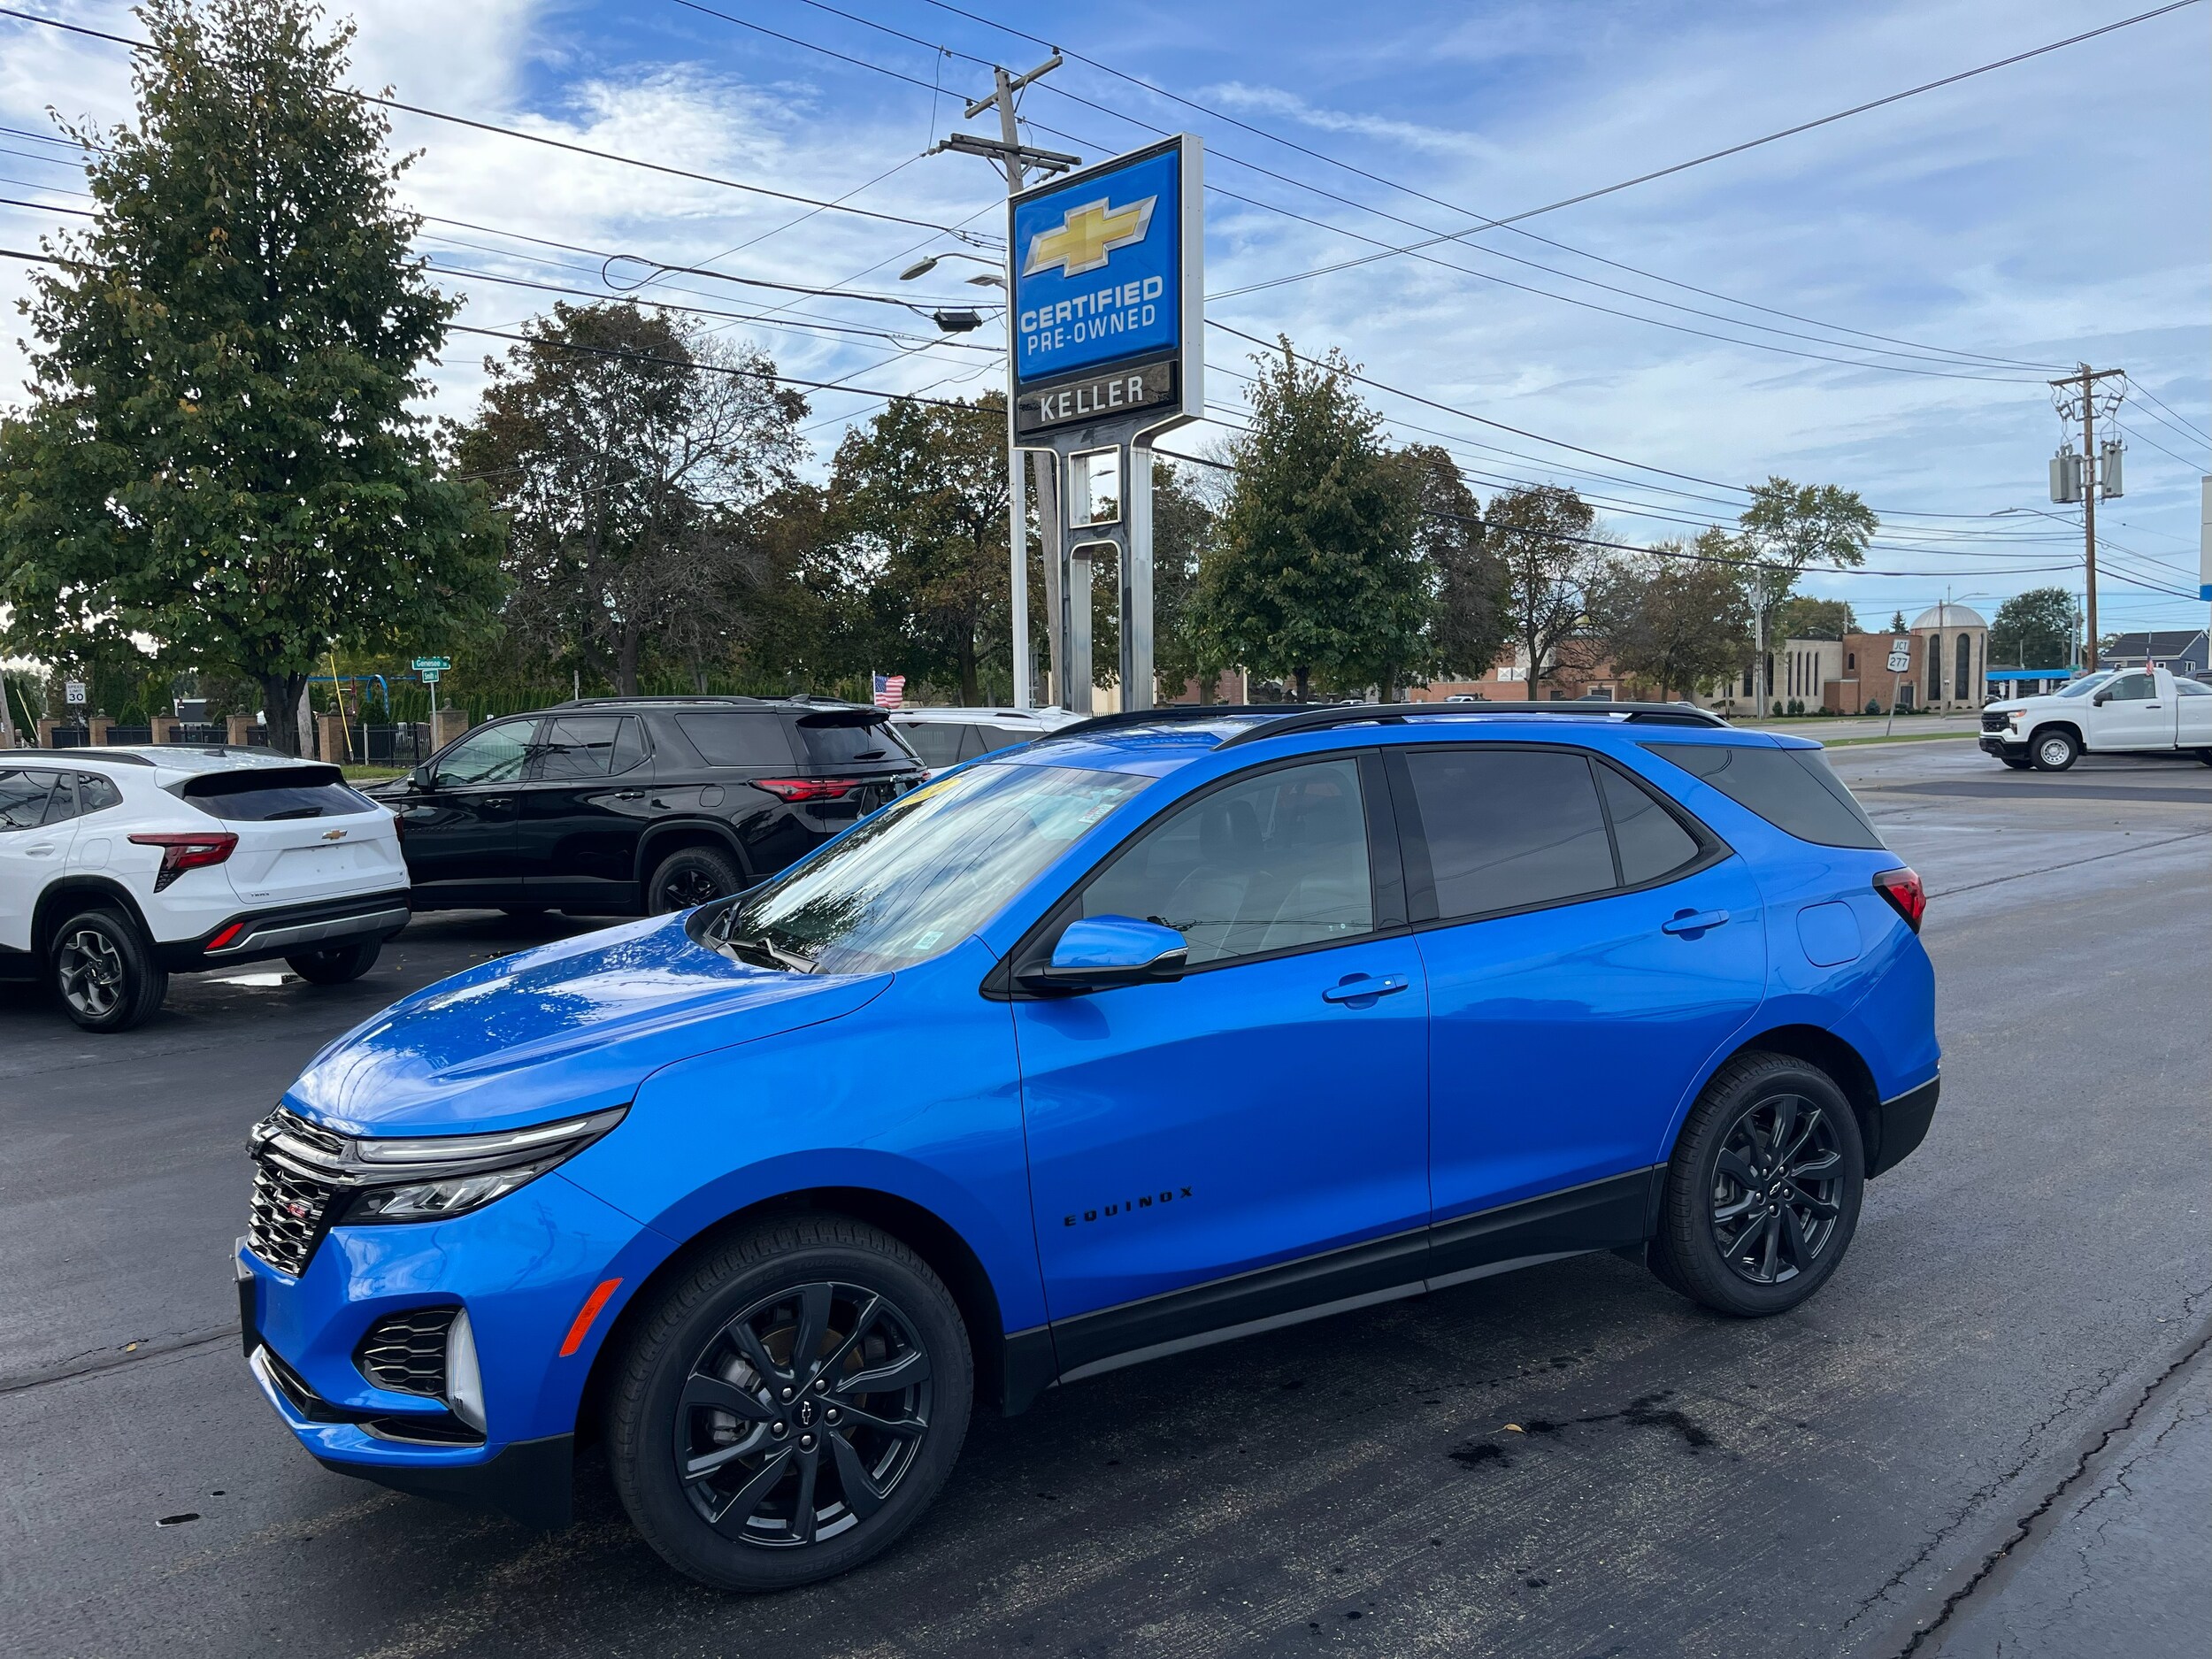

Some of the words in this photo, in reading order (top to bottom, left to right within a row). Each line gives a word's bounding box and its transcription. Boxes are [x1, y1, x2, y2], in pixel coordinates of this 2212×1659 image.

[1020, 275, 1164, 334] CERTIFIED
[1027, 304, 1156, 356] PRE-OWNED
[1041, 375, 1143, 422] KELLER
[1890, 657, 1908, 667] 277
[1894, 641, 1908, 650] JCT
[69, 693, 84, 702] 30
[1064, 1186, 1193, 1226] EQUINOX
